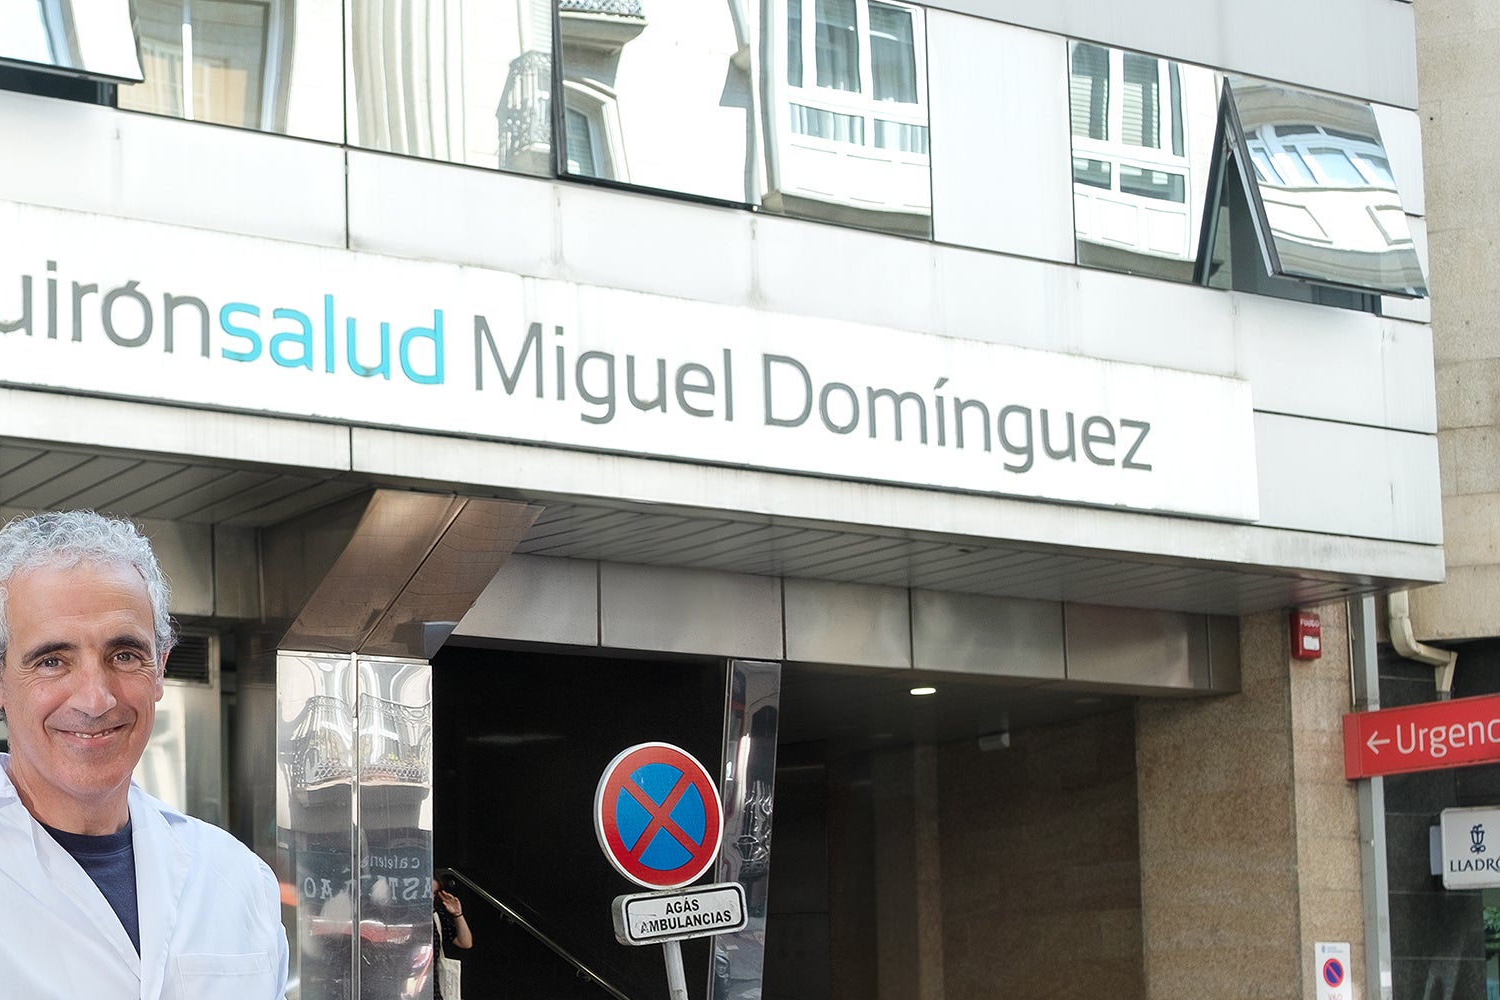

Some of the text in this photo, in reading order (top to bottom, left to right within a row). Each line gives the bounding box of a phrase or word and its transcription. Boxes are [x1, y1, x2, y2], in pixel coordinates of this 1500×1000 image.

[474, 315, 734, 426] Miguel
[763, 353, 1152, 475] Domínguez
[666, 897, 699, 915] AGÁS
[640, 910, 731, 934] AMBULANCIAS
